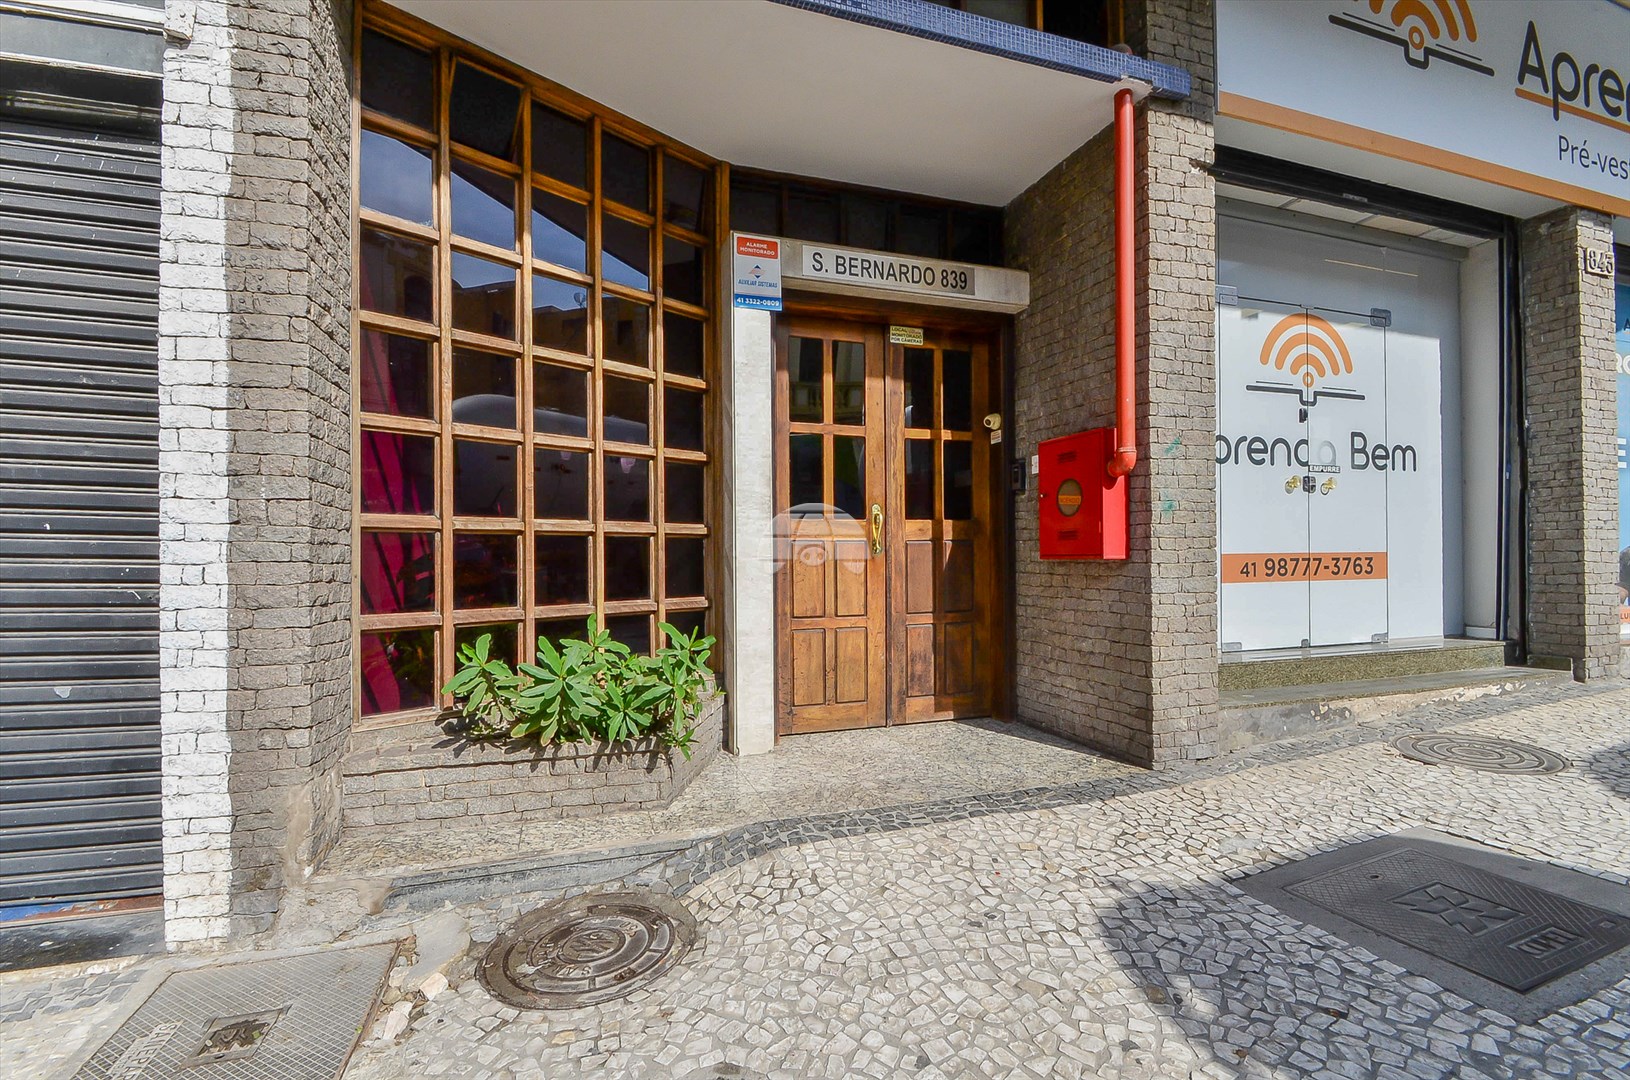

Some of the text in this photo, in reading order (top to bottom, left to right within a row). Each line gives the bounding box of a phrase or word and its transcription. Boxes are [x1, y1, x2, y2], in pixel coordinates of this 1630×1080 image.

[1517, 20, 1630, 122] Apre
[1559, 135, 1630, 179] Pré-ves
[740, 247, 775, 256] MONITORADO
[812, 252, 967, 290] S. BERNARDO 839
[1310, 465, 1340, 473] EMPURRE
[1351, 432, 1417, 472] Bem
[1239, 557, 1374, 577] 41 98777-3763
